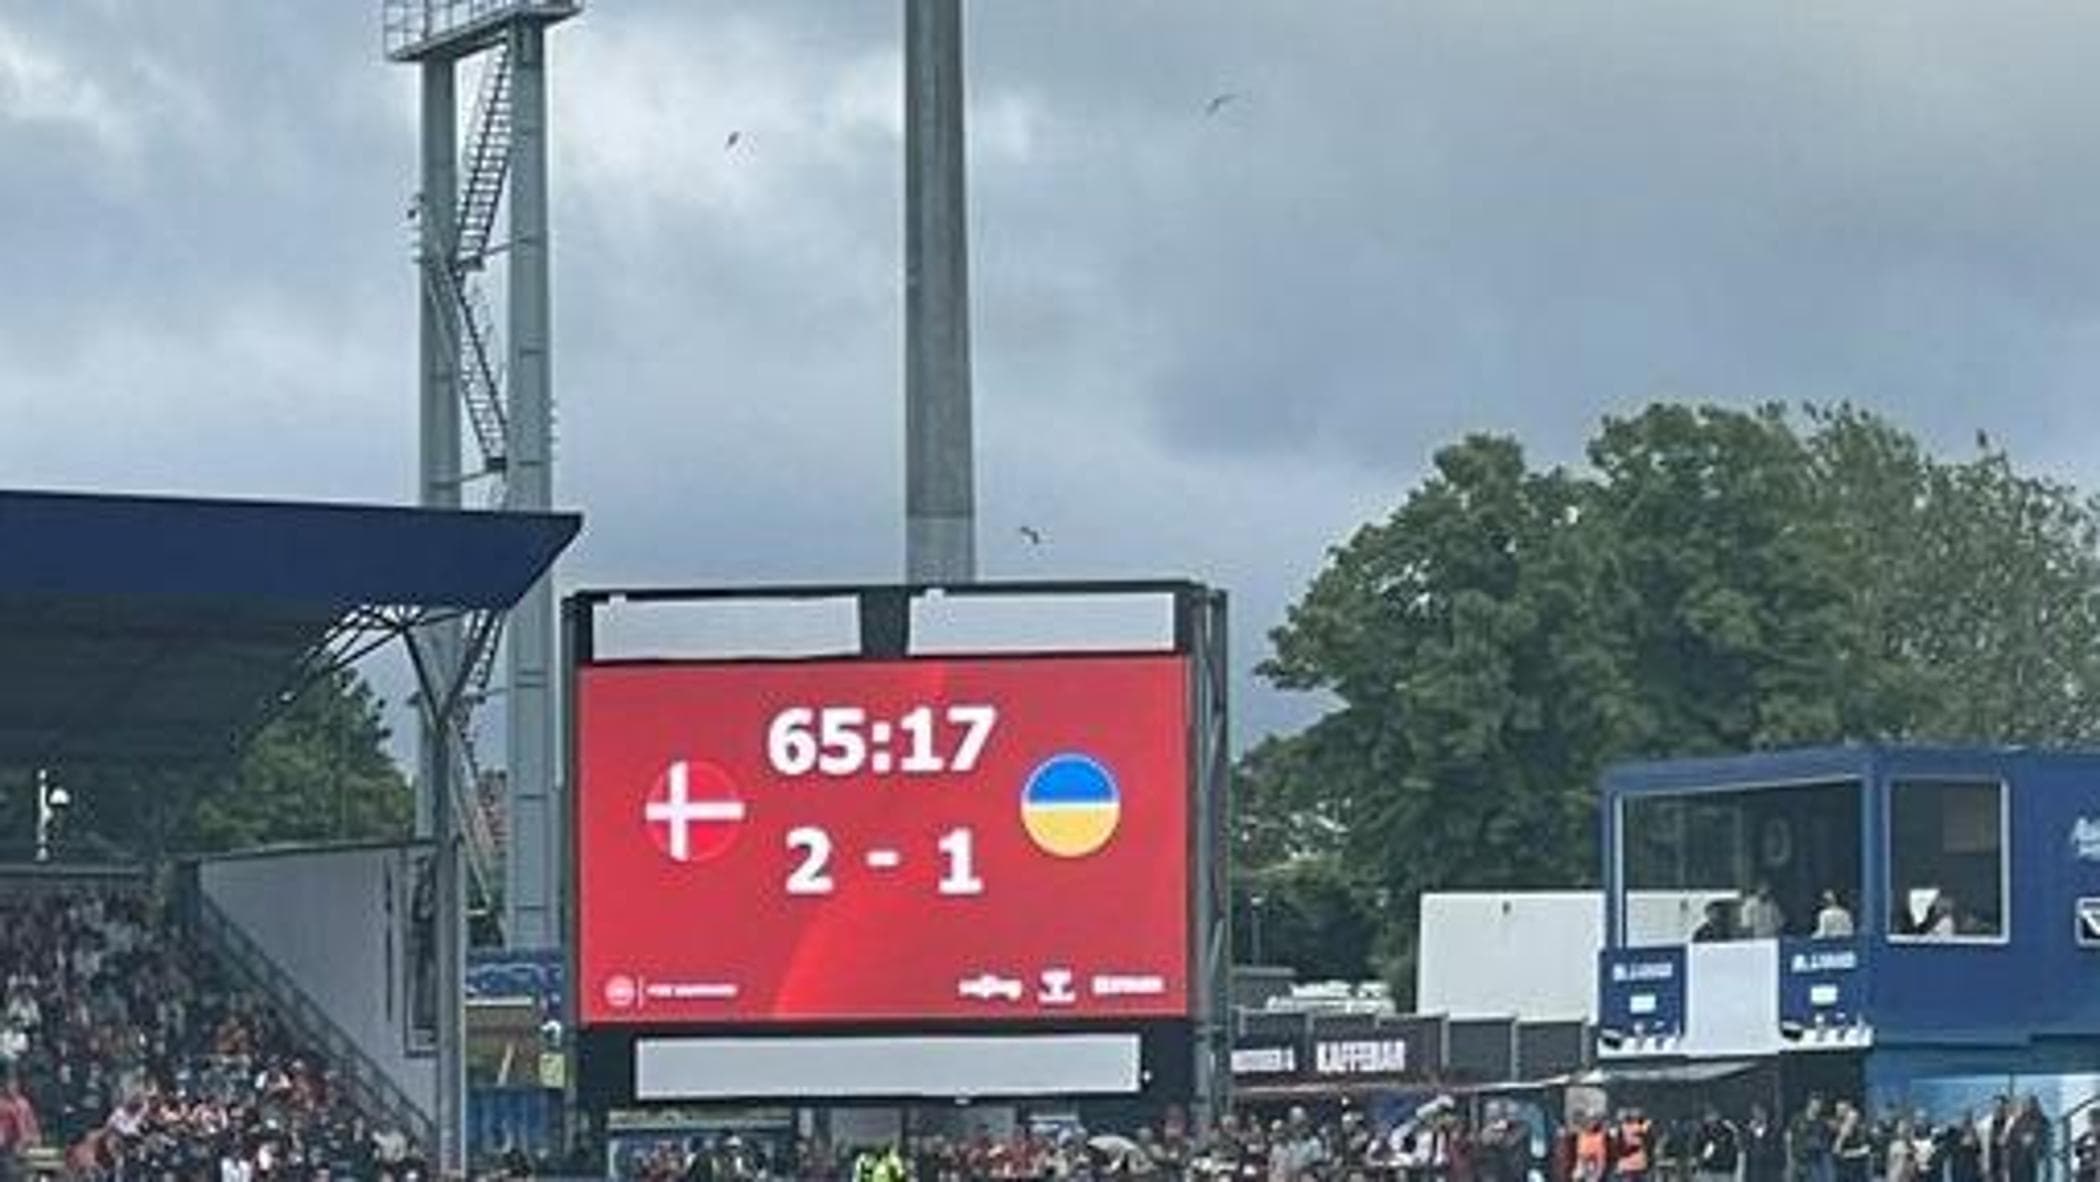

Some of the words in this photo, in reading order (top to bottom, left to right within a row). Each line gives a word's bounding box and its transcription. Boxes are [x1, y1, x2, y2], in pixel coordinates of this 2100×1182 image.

[767, 705, 997, 775] 65:17
[785, 827, 833, 894] 2
[866, 850, 898, 868] -
[938, 827, 983, 894] 1
